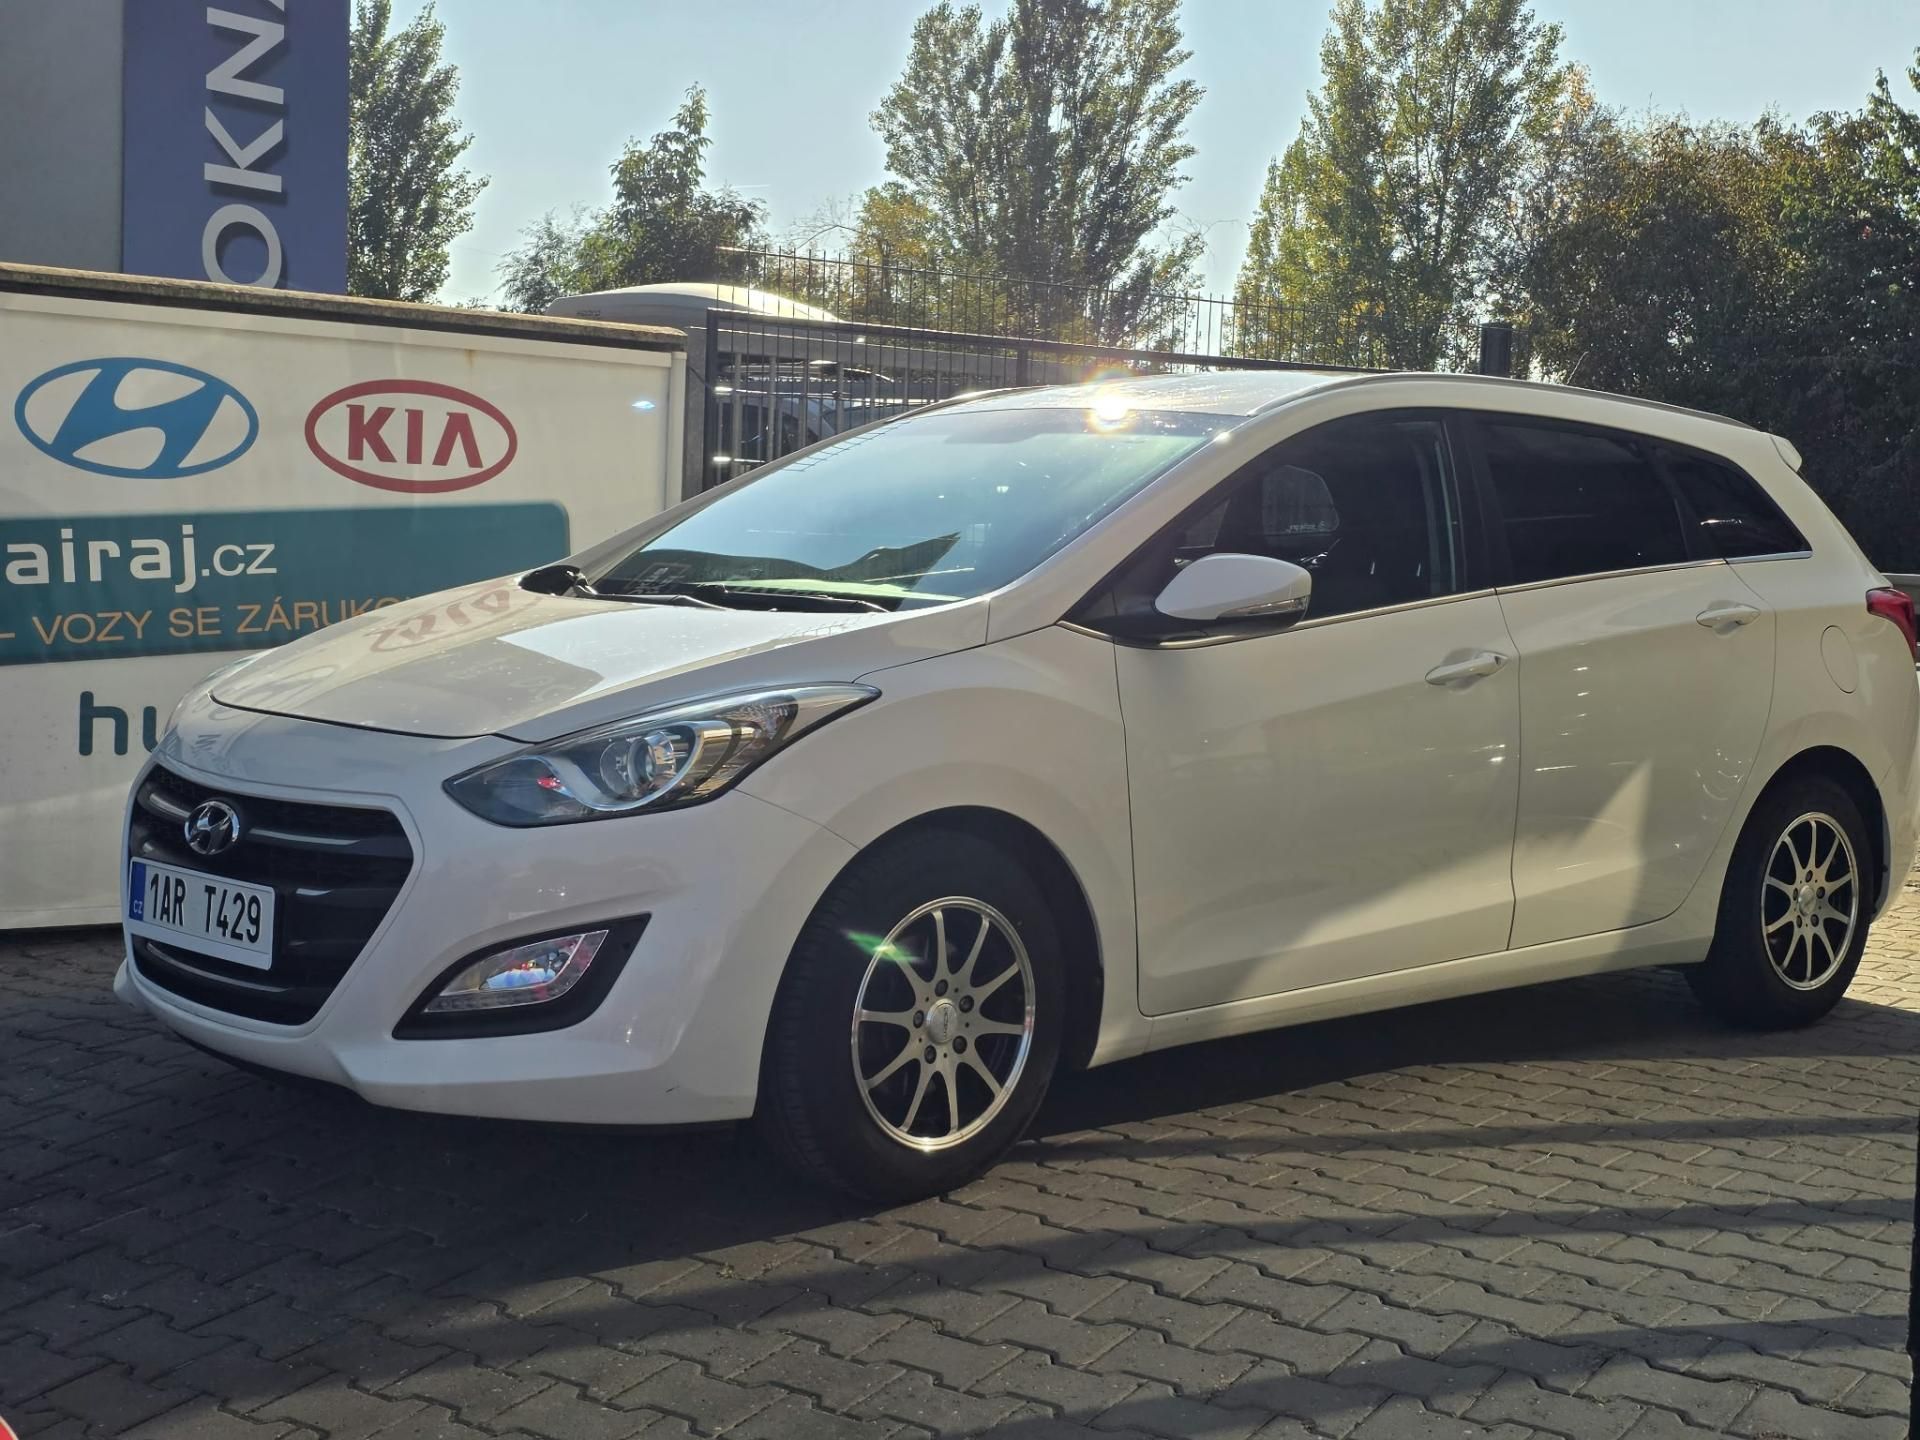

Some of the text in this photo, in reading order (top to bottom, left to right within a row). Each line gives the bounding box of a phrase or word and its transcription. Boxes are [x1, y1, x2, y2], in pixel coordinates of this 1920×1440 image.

[202, 0, 285, 290] OKN
[346, 404, 484, 469] KIA
[5, 524, 278, 594] airaj.cz
[31, 610, 152, 646] VOZY
[168, 606, 222, 638] SE
[236, 596, 411, 634] ZÁRUK
[133, 899, 143, 914] CZ
[150, 873, 262, 944] 1AR T429
